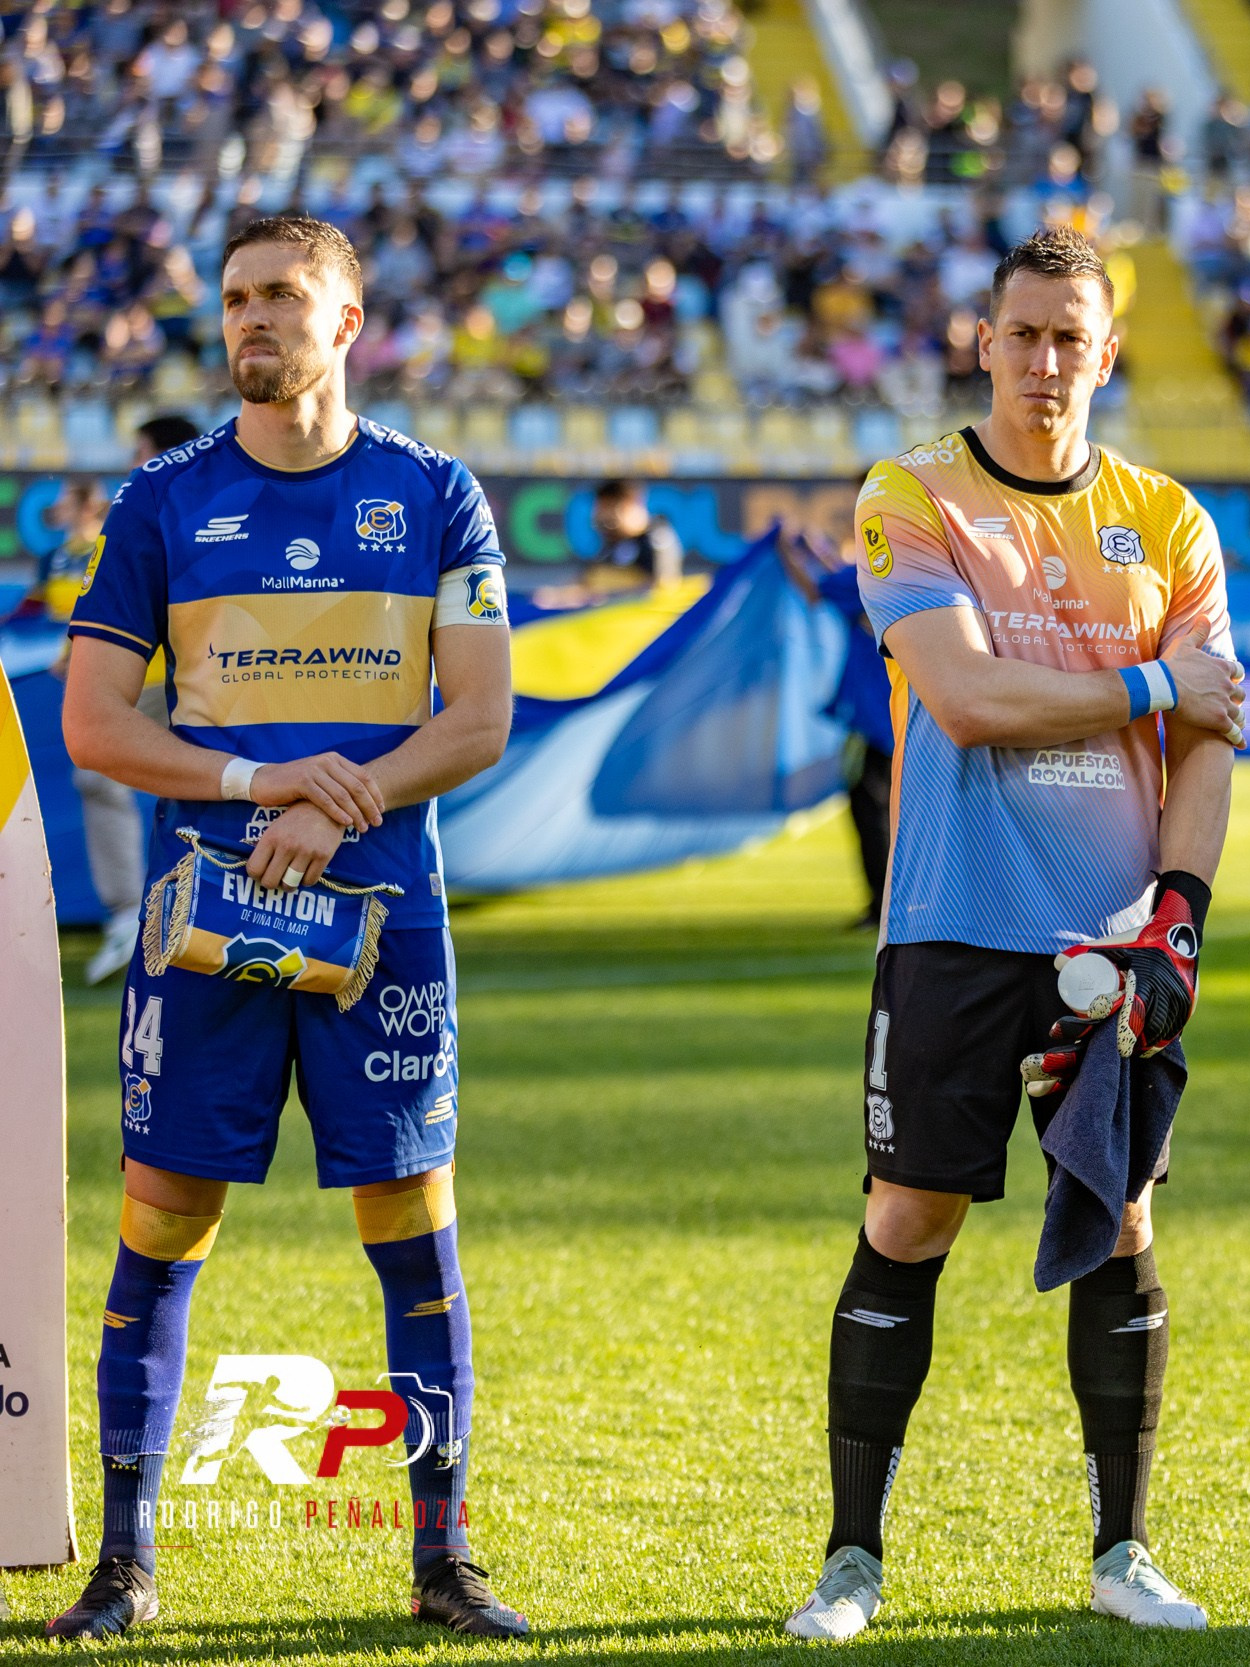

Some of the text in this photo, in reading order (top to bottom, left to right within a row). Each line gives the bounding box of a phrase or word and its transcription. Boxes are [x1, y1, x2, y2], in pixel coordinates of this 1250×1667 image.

[142, 434, 216, 472] Claro
[195, 533, 249, 543] SKECHERS
[262, 576, 339, 589] MallMarina
[993, 633, 1050, 646] GLOBAL
[217, 647, 402, 669] TERRAWIND
[222, 670, 401, 684] GLOBAL PROTECTION
[1036, 753, 1120, 770] APUESTAS
[222, 871, 338, 927] EVERTON
[240, 908, 310, 936] DE VIÑA DEL MAR
[869, 1010, 890, 1091] 1
[364, 1050, 448, 1082] Claro
